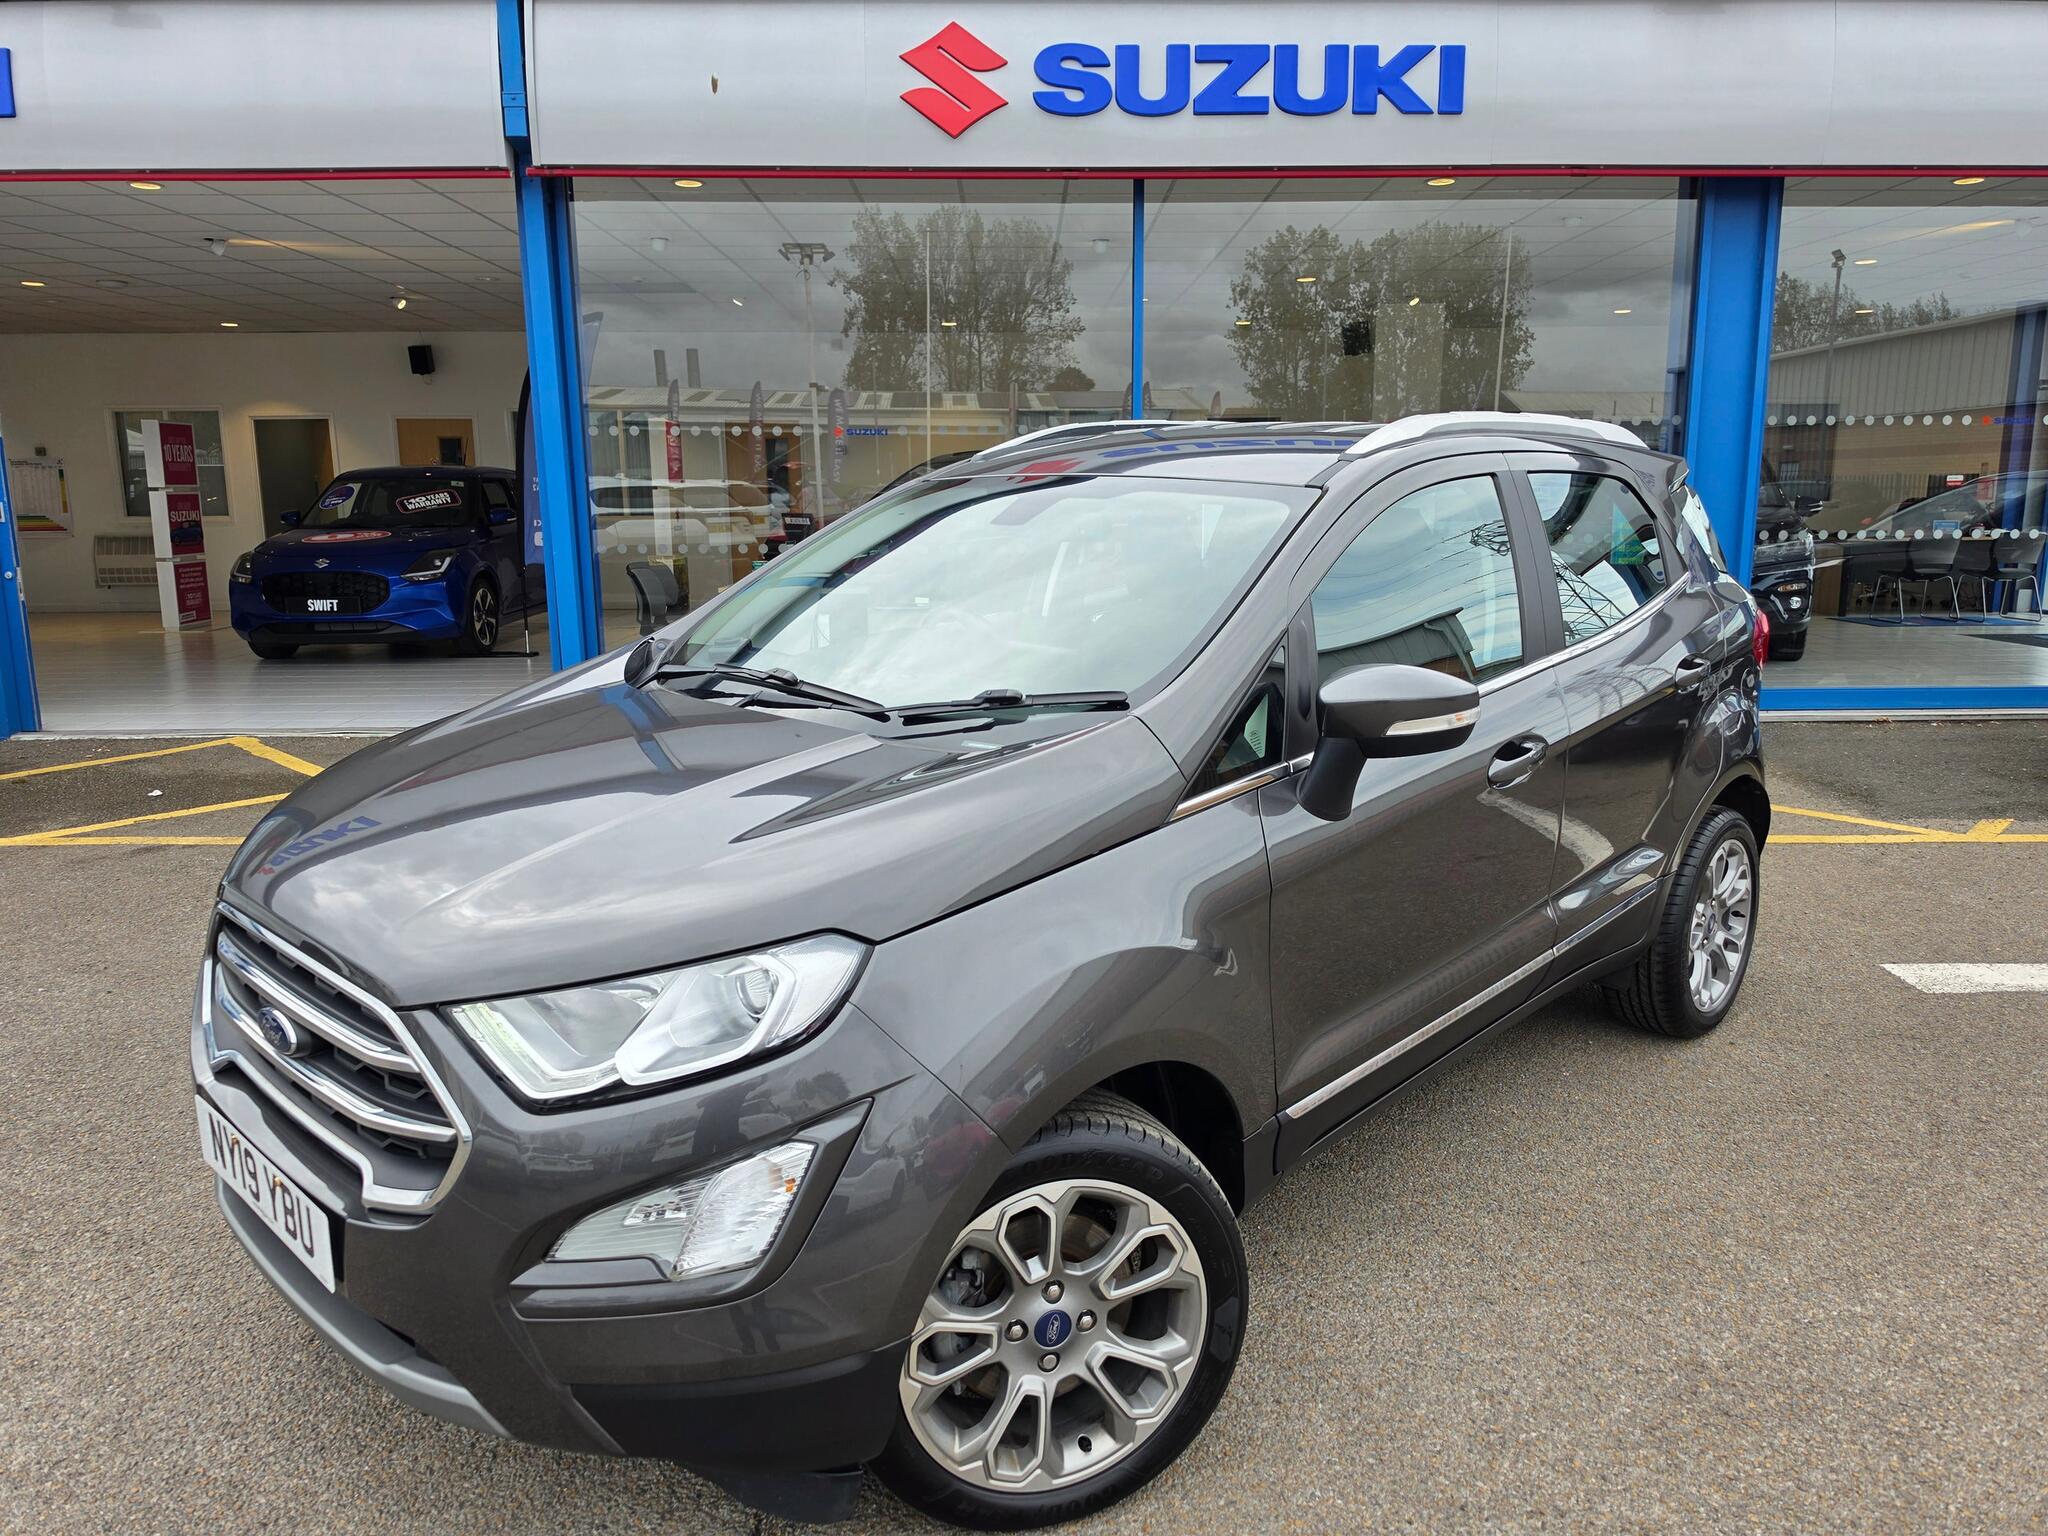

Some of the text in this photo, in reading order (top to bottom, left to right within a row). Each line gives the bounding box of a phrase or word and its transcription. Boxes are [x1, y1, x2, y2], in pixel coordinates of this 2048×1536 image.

[1033, 43, 1465, 117] SUZUKI
[846, 428, 888, 436] SUZUKI
[163, 444, 193, 463] 10 YEARS
[425, 492, 449, 501] YEARS
[406, 497, 451, 510] WARRANTY
[170, 510, 200, 522] SUZUKI
[307, 599, 338, 612] SWIFT
[261, 1014, 283, 1046] Ford
[208, 1111, 316, 1259] NY19 YBU
